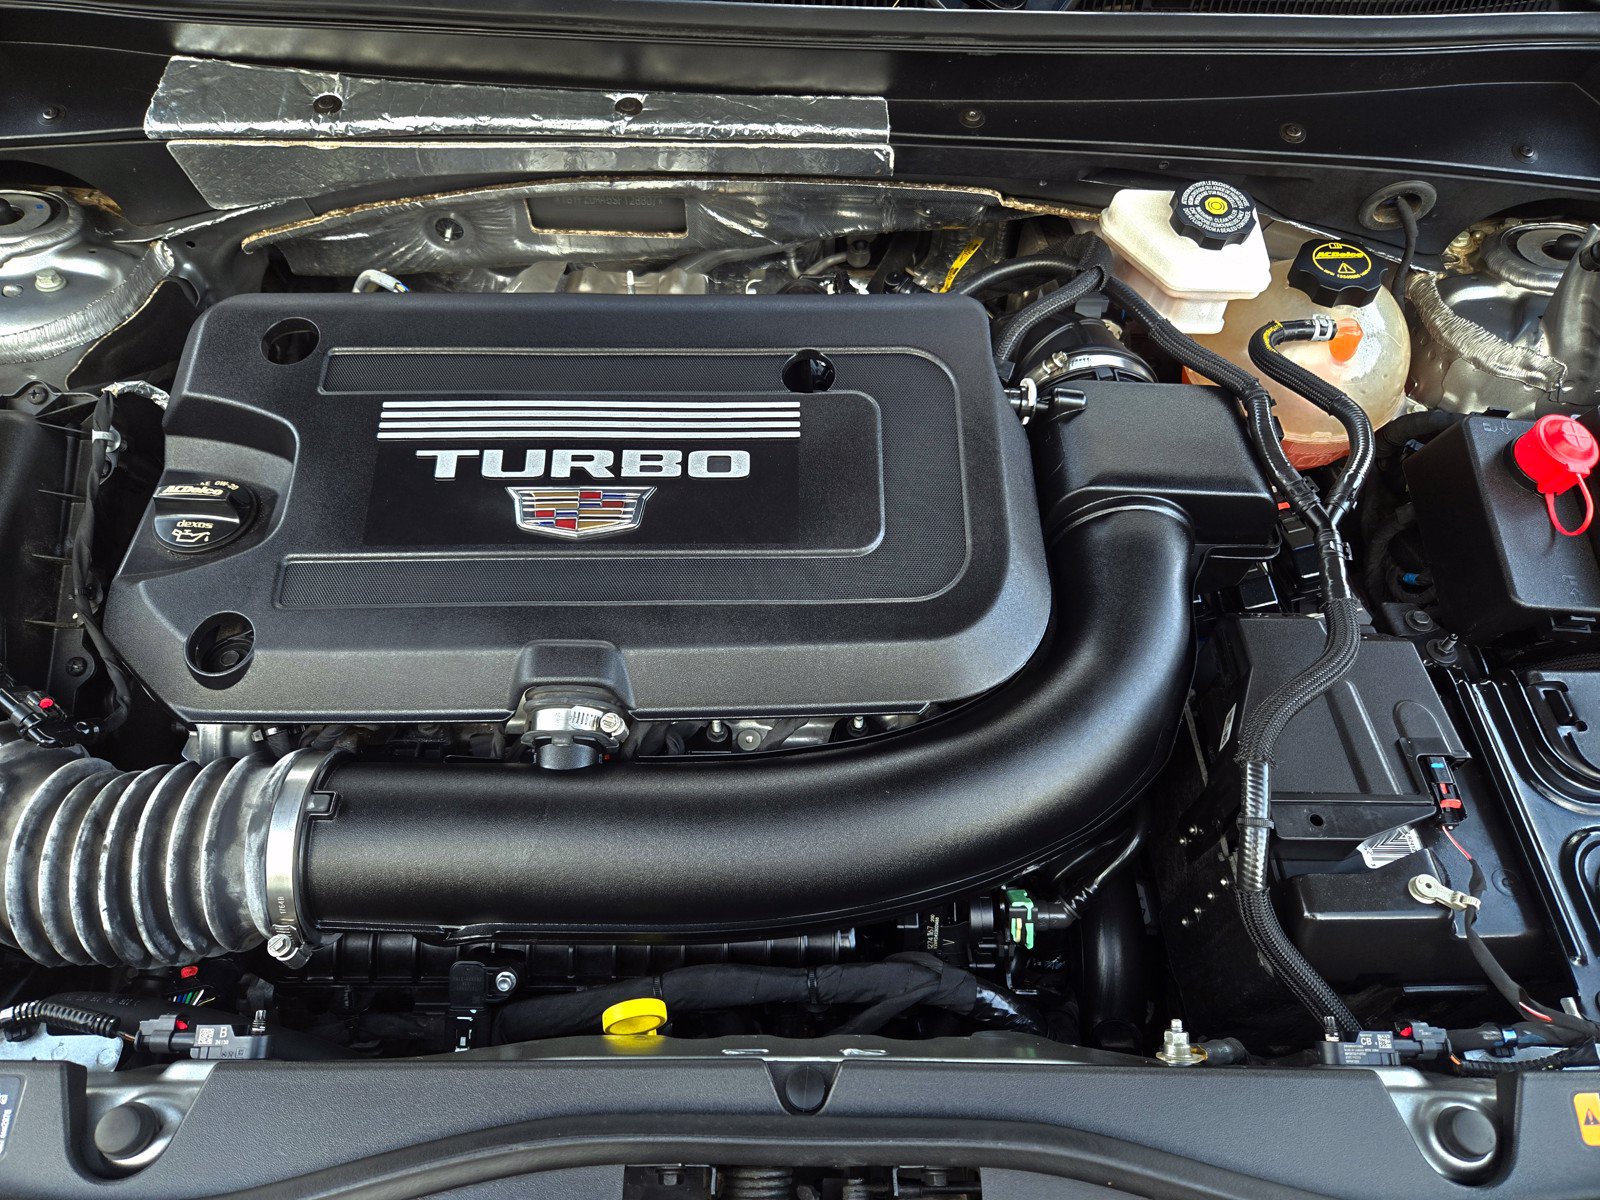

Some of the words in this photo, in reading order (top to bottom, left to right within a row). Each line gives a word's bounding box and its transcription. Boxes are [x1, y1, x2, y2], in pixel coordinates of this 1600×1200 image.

[1315, 251, 1364, 259] ACDelco
[416, 449, 751, 479] TURBO
[159, 485, 223, 496] ACDelco
[176, 520, 214, 529] dexos
[220, 1026, 228, 1038] B
[1360, 1037, 1372, 1046] CB
